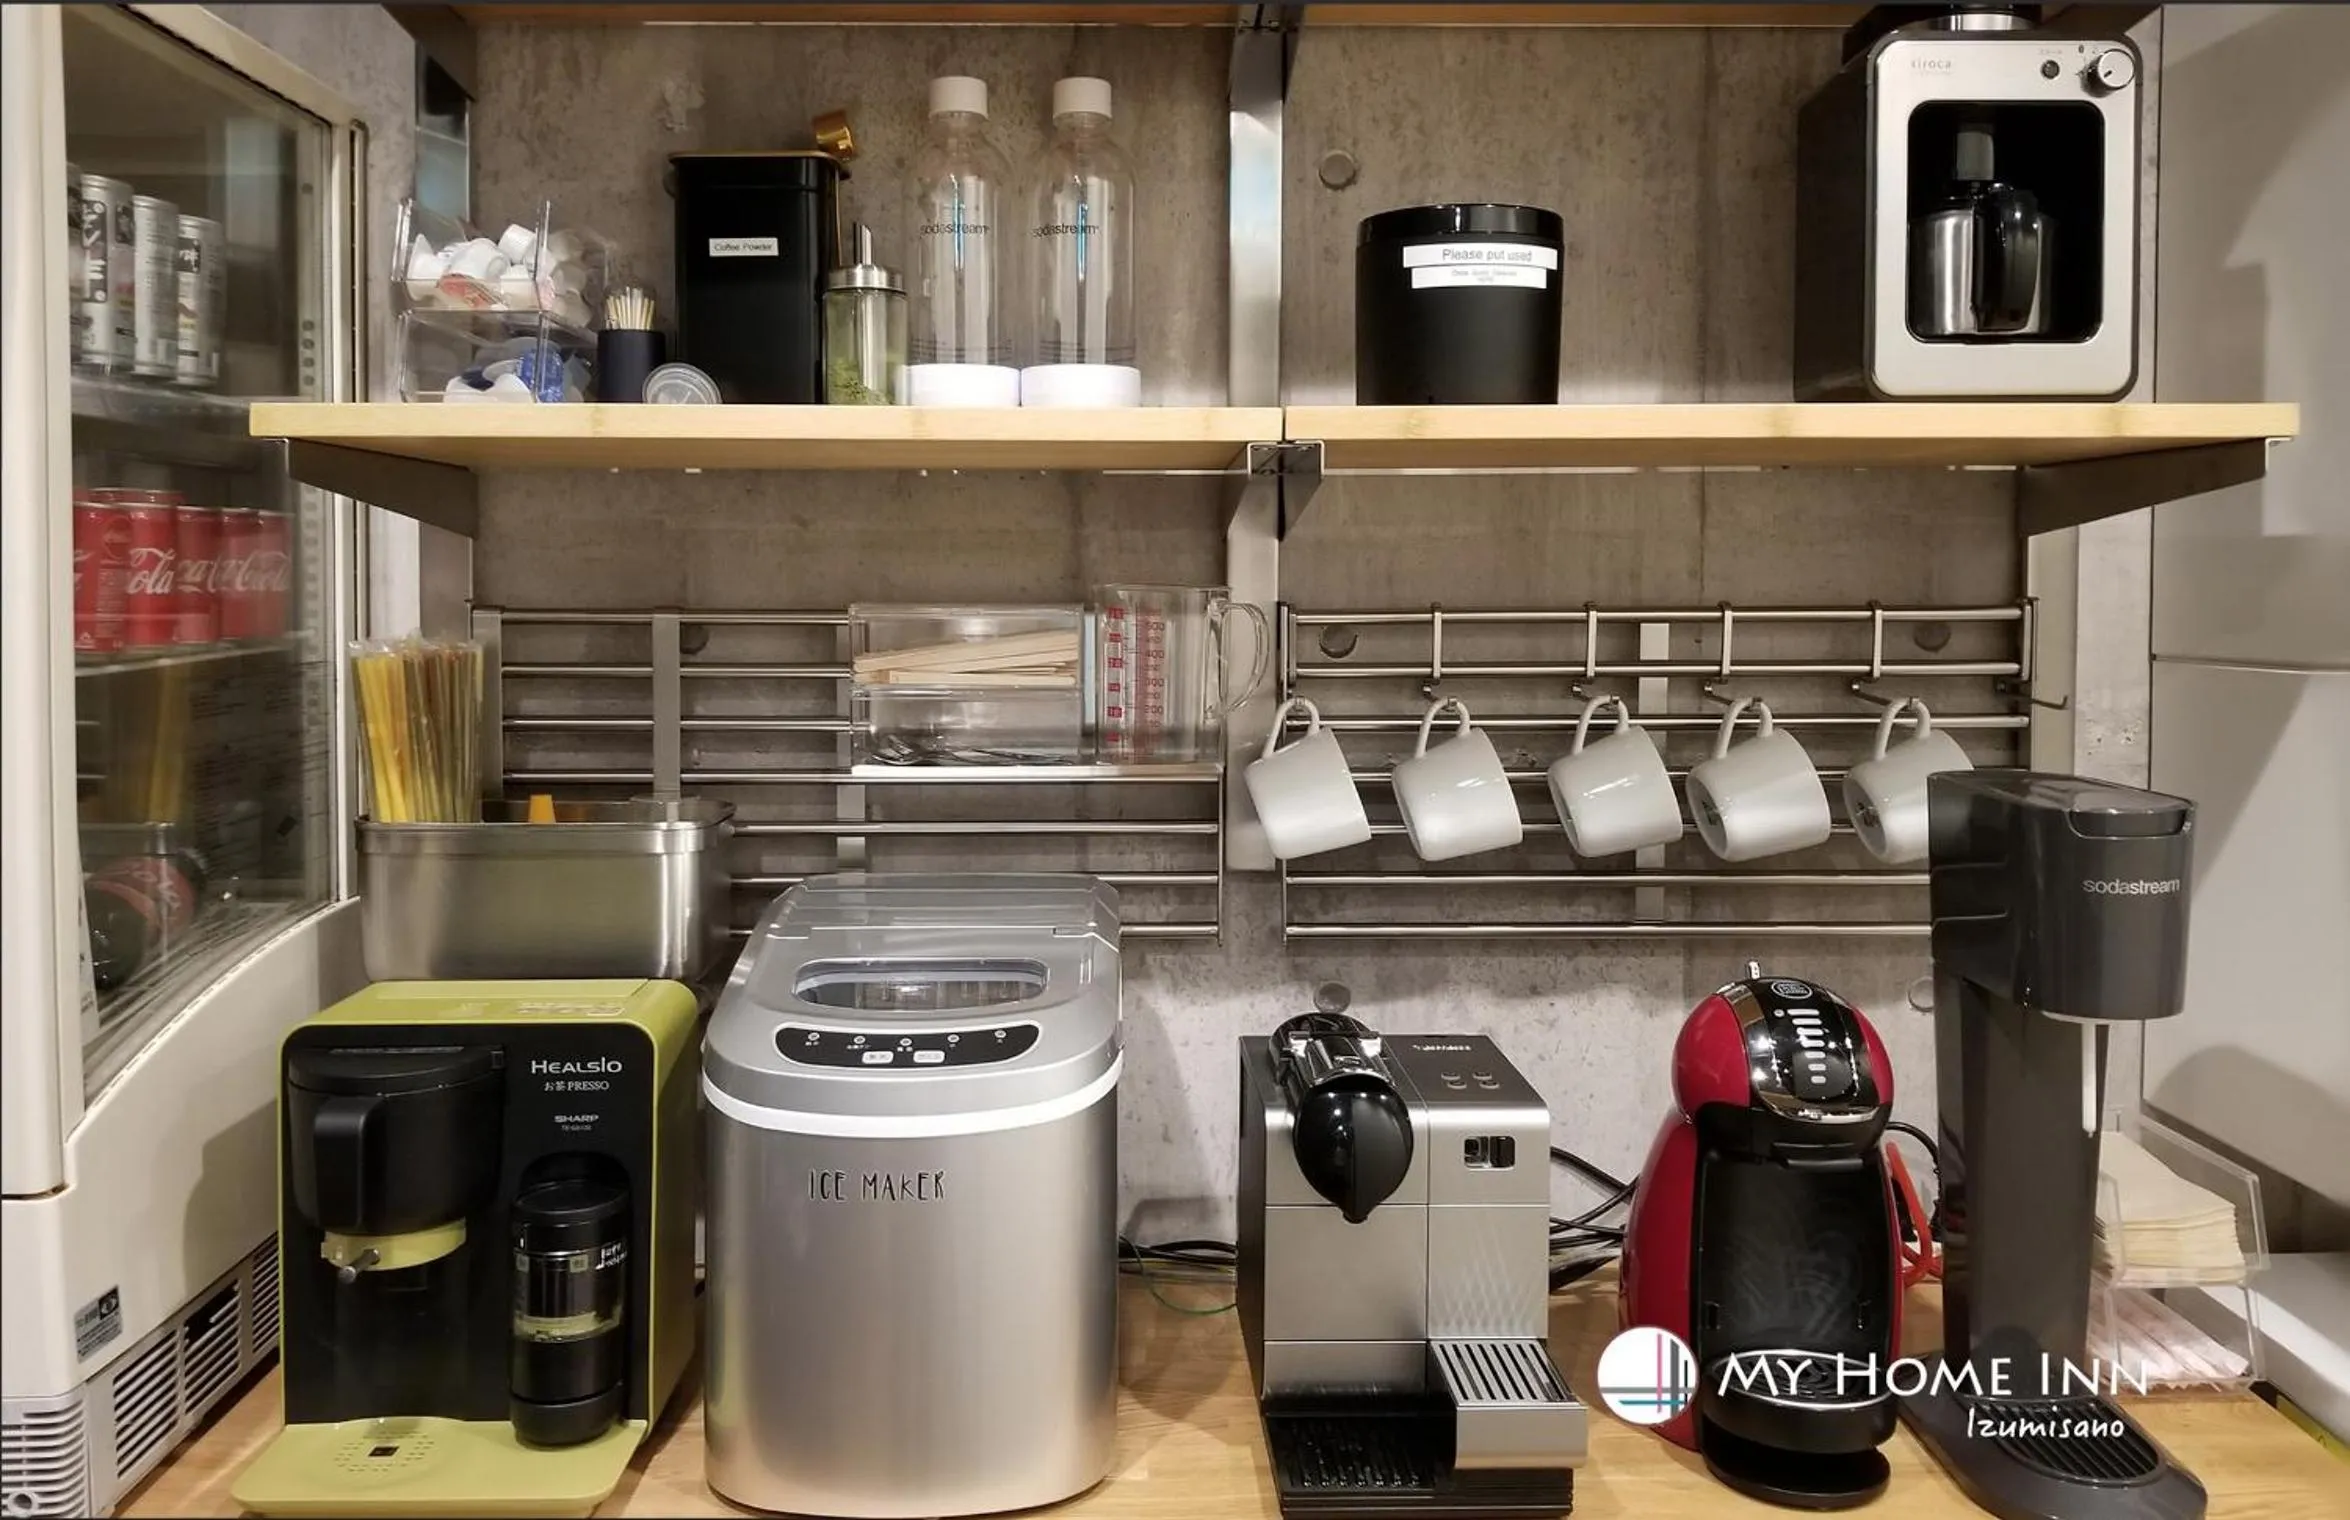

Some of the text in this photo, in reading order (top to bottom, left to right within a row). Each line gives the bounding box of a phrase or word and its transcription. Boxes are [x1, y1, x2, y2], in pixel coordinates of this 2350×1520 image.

[1442, 248, 1483, 261] Please
[1486, 250, 1505, 262] put
[2082, 878, 2181, 896] sodastream
[554, 1114, 600, 1123] SHARP
[808, 1168, 946, 1201] ICE MAKER
